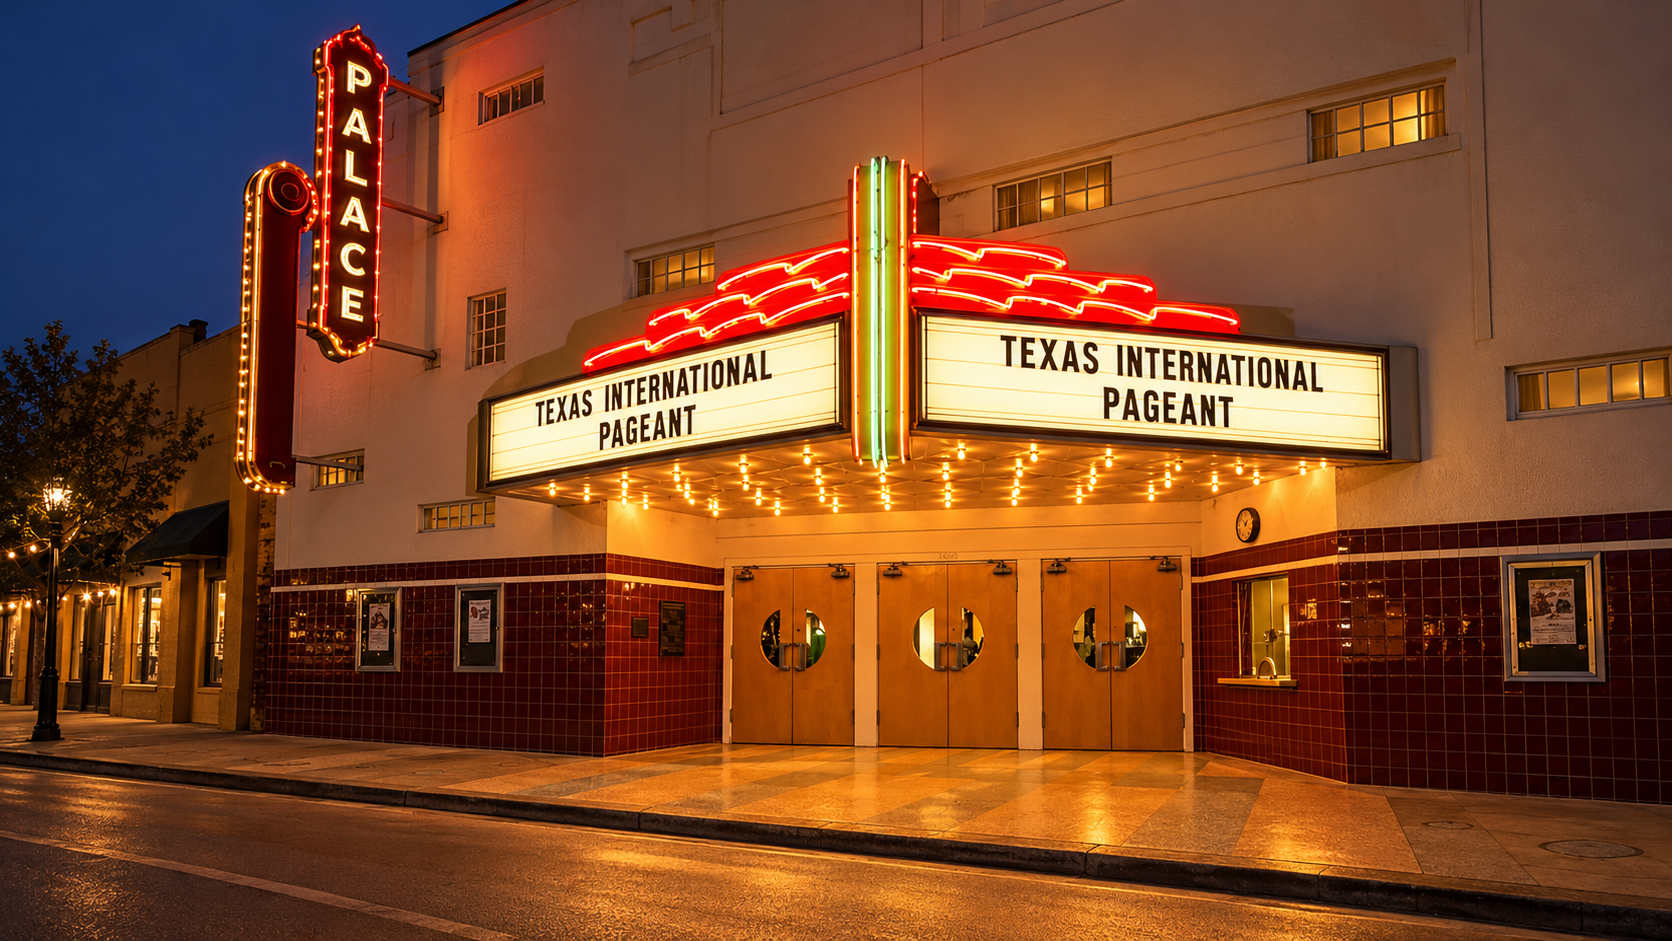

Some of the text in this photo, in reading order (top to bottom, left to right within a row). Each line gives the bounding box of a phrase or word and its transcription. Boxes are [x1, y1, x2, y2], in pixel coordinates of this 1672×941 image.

[340, 61, 372, 323] PALACE
[535, 350, 773, 427] TEXAS INTERNATIONAL
[1000, 335, 1324, 393] TEXAS INTERNATIONAL
[599, 404, 697, 450] PAGEANT
[1103, 387, 1234, 428] PAGEANT
